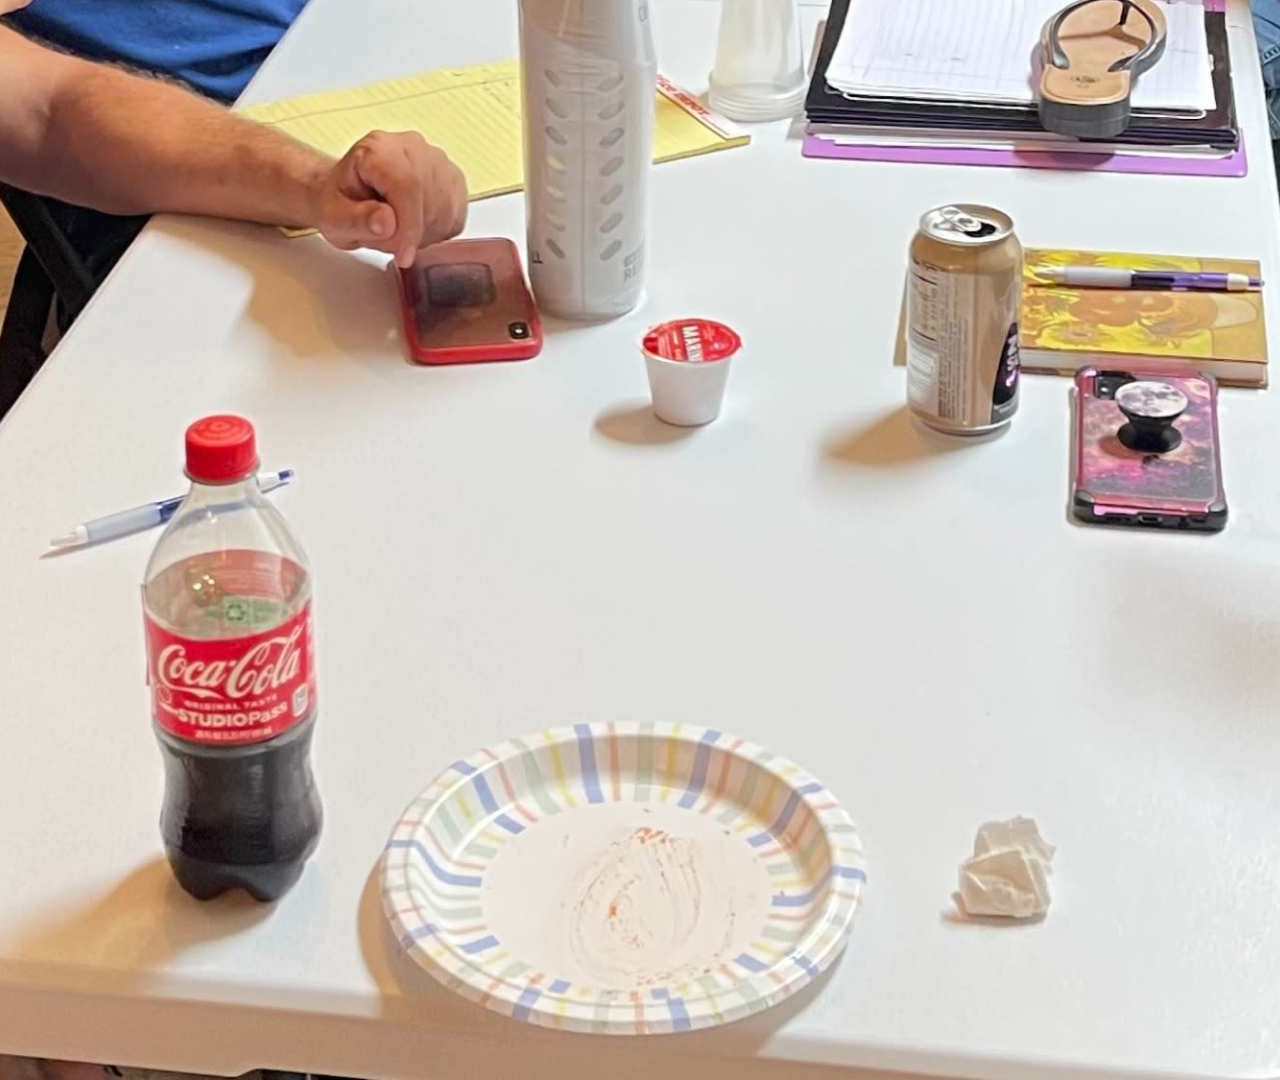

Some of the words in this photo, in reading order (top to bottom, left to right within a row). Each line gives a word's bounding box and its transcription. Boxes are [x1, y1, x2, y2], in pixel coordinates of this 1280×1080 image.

[158, 624, 304, 699] Coca-Cola
[184, 700, 241, 711] ORIGINAL
[244, 694, 278, 710] TASTE
